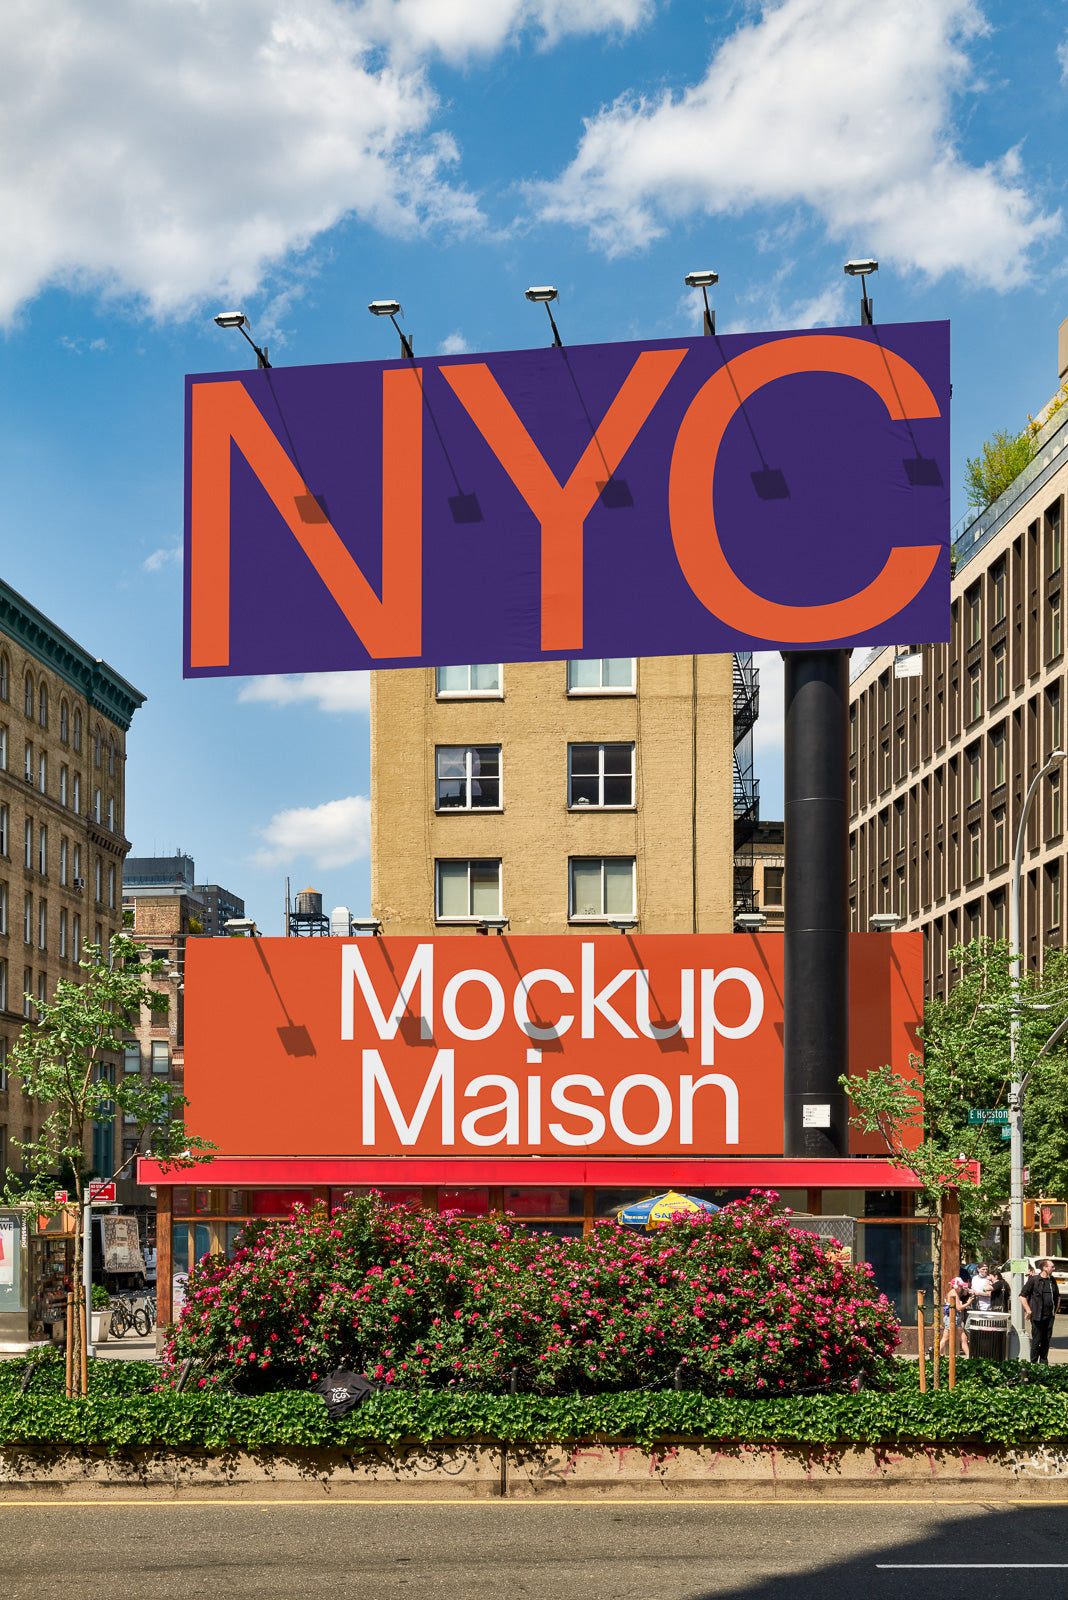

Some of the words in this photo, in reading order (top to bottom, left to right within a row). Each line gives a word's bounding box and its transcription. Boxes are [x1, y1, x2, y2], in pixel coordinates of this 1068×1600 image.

[191, 335, 941, 668] NYC
[340, 942, 765, 1066] Mockup
[361, 1049, 739, 1147] Maison
[970, 1110, 974, 1119] E
[977, 1110, 1008, 1119] Houston
